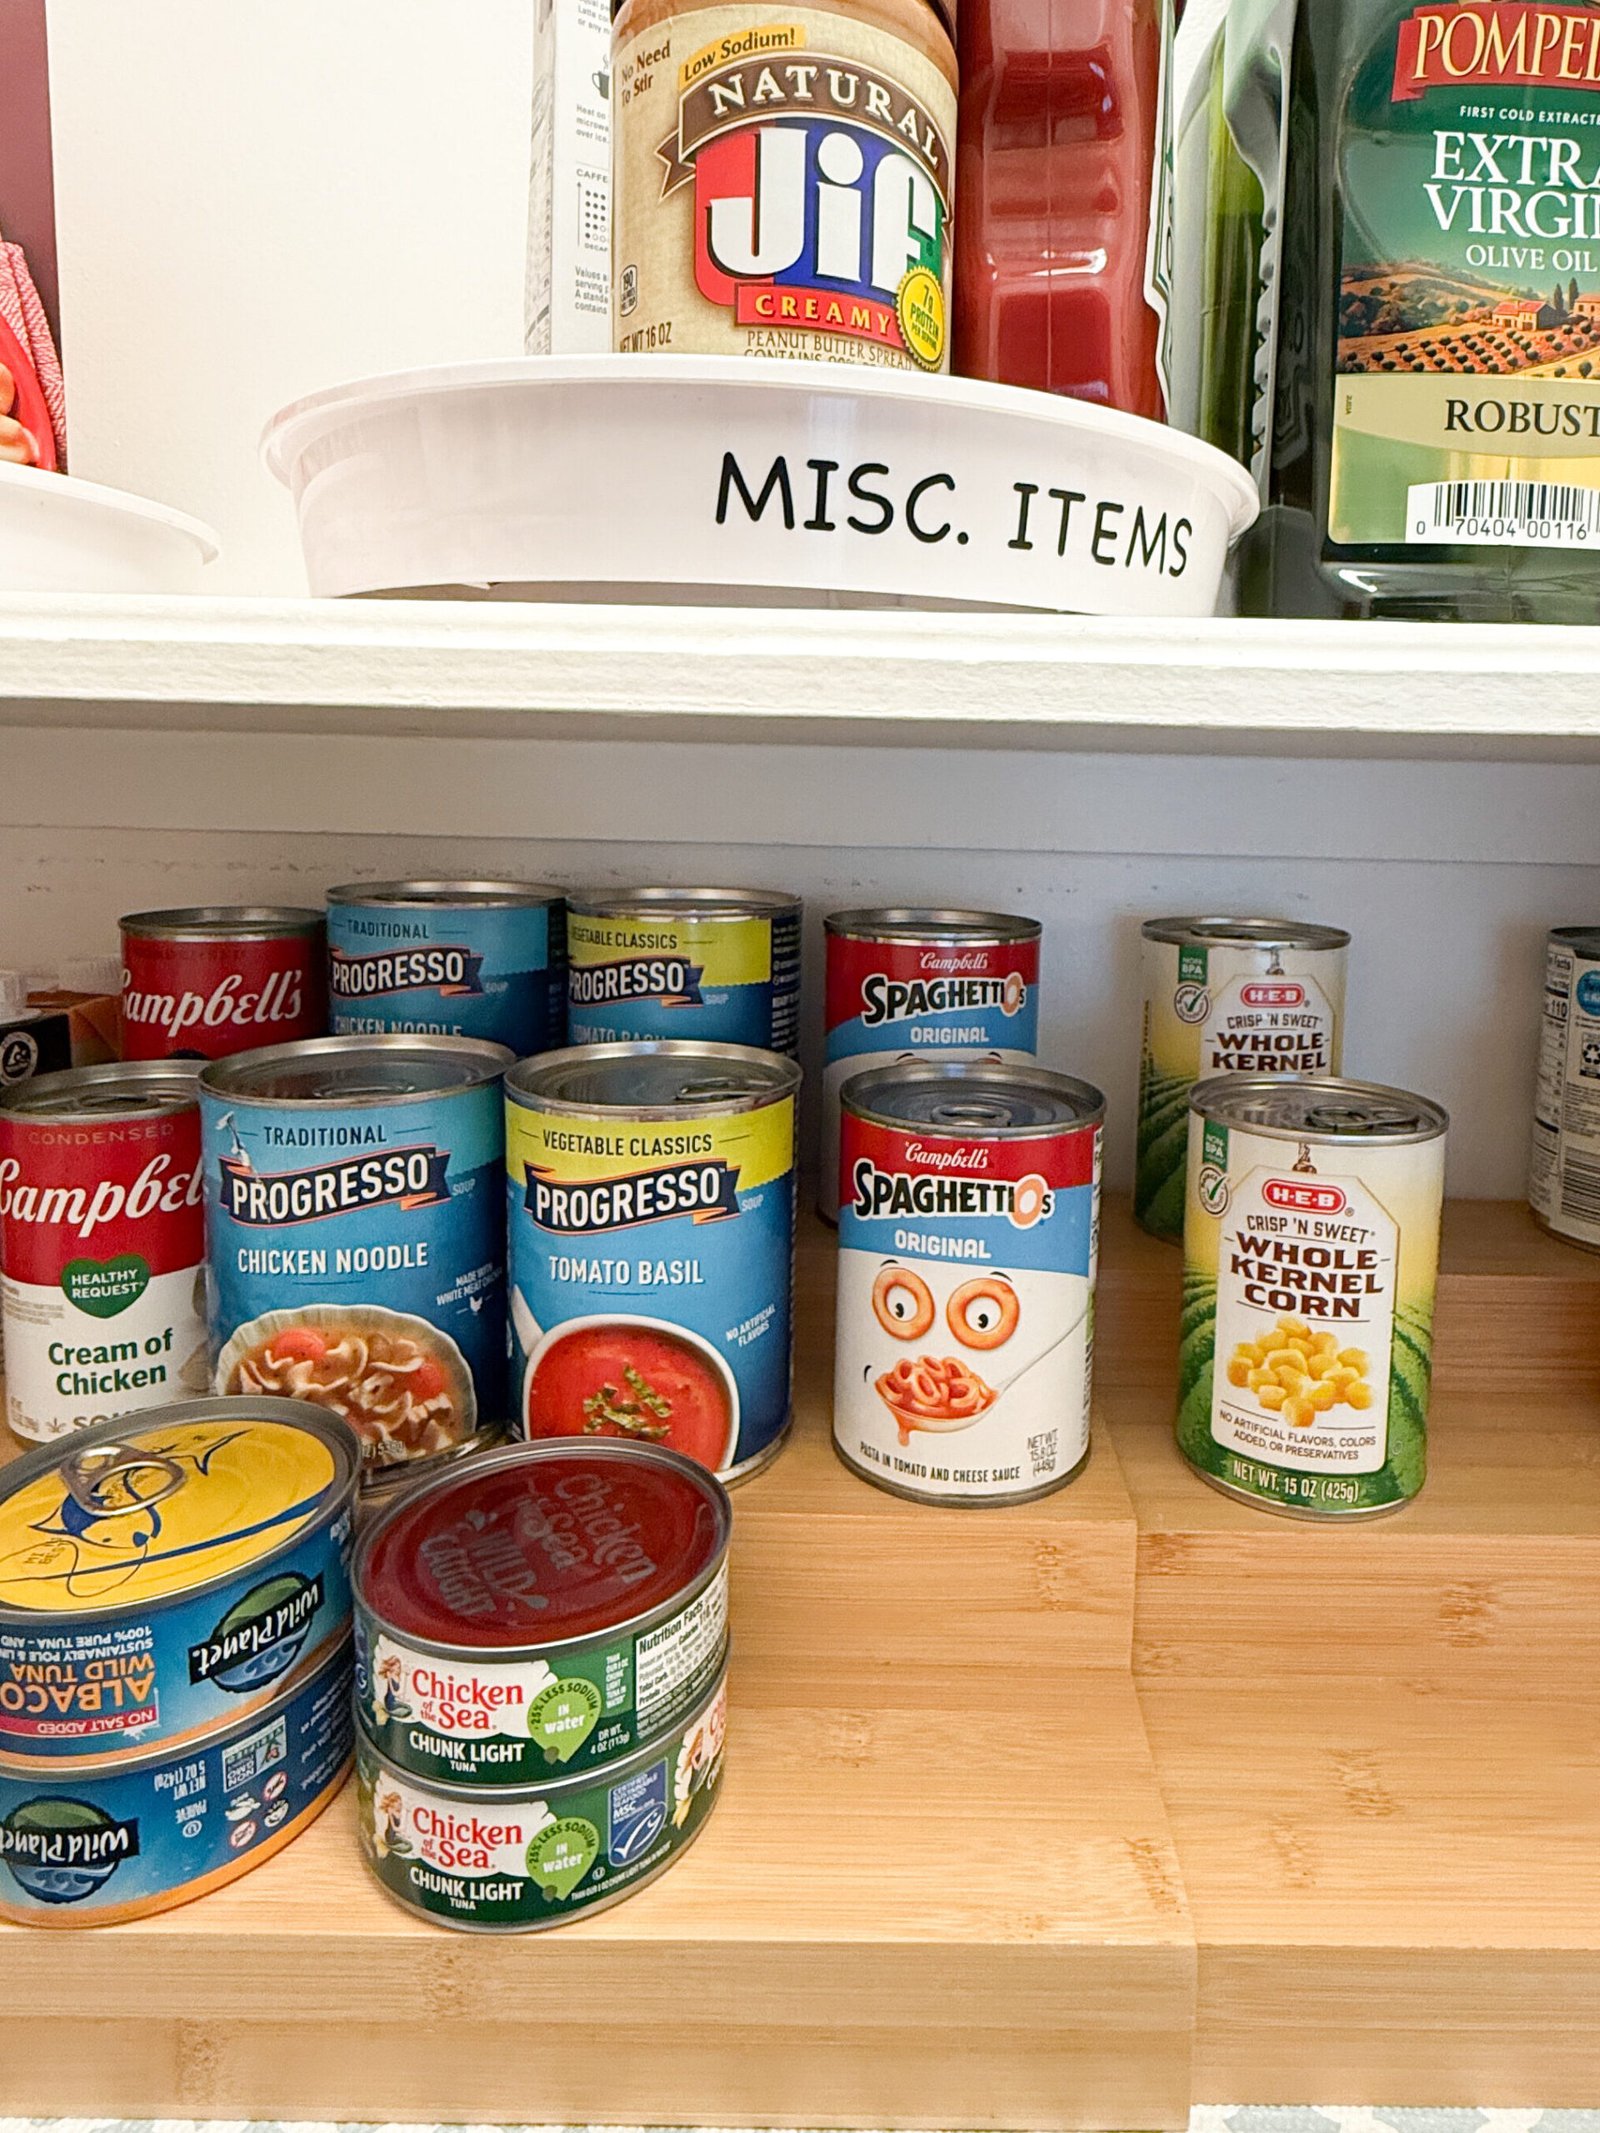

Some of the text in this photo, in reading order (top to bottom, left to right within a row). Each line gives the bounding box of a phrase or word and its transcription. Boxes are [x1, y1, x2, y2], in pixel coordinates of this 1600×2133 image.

[621, 40, 671, 86] No Need
[684, 27, 795, 82] Low Sodium!
[634, 73, 653, 98] Stir
[708, 64, 938, 166] NATURAL
[1460, 106, 1495, 119] FIRST
[1500, 108, 1534, 122] COLD
[1431, 130, 1600, 189] EXTR
[705, 127, 936, 295] Jif
[1423, 184, 1600, 239] VIRGI
[1466, 245, 1598, 272] OLIVE OIL
[755, 294, 890, 336] CREAMY
[910, 302, 939, 341] PROTEIN
[631, 322, 672, 352] WT 16 OZ
[747, 330, 808, 349] PEANUT
[814, 333, 865, 359] BUTTER
[869, 346, 912, 371] SPREAD
[715, 451, 1193, 578] MISC. ITEMS
[1416, 518, 1587, 541] 0 70404 00116
[347, 919, 430, 939] TRADITIONAL
[616, 932, 677, 949] CLASSICS
[332, 952, 464, 995] PROGRESSO
[920, 951, 988, 972] Campbell's
[1182, 964, 1202, 974] BPA
[569, 962, 684, 1001] PROGRESSO
[910, 1027, 989, 1043] ORIGINAL
[1227, 1015, 1319, 1029] CRISP SWEET
[1216, 1032, 1324, 1051] WHOLE
[1212, 1052, 1326, 1072] KERNEL
[28, 1123, 174, 1146] CONDENSED
[264, 1125, 387, 1147] TRADITIONAL
[543, 1129, 712, 1156] VEGETABLE CLASSICS
[905, 1141, 988, 1170] Campbell's
[232, 1153, 476, 1221] PROGRESSO SOUP
[536, 1167, 764, 1227] PROGRESSO SOUP
[1247, 1215, 1369, 1244] CRISP SWEET
[895, 1229, 992, 1259] ORIGINAL
[1236, 1231, 1378, 1270] WHOLE
[238, 1242, 428, 1274] CHICKEN NOODLE
[549, 1256, 704, 1285] TOMATO BASIL
[71, 1269, 138, 1286] HEALTHY
[456, 1271, 477, 1287] MADE
[1231, 1253, 1384, 1294] KERNEL
[72, 1281, 139, 1299] REQUEST
[436, 1288, 462, 1306] WHITE
[1244, 1283, 1361, 1318] CORN
[725, 1303, 775, 1341] NO ARTIFICIAL
[738, 1320, 770, 1347] FLAVORS
[48, 1327, 173, 1366] Cream of
[56, 1364, 167, 1396] Chicken
[1027, 1434, 1043, 1449] NET
[1219, 1409, 1376, 1447] NO ARTIFICIAL FLAVORS, COLORS
[1233, 1430, 1359, 1460] ADDED, OR PRESERVATIVES
[860, 1441, 1020, 1483] PASTA IN TOMATO AND CHEESE SAUCE
[1233, 1460, 1359, 1503] NET WT. 15 OZ (425g)
[277, 1583, 318, 1633] Wild
[76, 1632, 111, 1647] PURE
[115, 1626, 152, 1642] 100%
[639, 1600, 703, 1655] Nutrition Facts
[28, 1637, 154, 1663] SUSTAINABLY POLE
[37, 1636, 72, 1649] TUNA
[10, 1653, 155, 1683] WILD TUNA
[412, 1669, 524, 1711] Chicken
[540, 1682, 598, 1711] LESS SODIUM
[420, 1710, 436, 1722] the
[422, 1701, 433, 1712] of
[438, 1703, 490, 1729] Sea
[558, 1703, 569, 1716] IN
[37, 1709, 153, 1735] NO SALT ADDED
[544, 1715, 584, 1735] water
[410, 1730, 524, 1762] CHUNK LIGHT
[227, 1768, 254, 1787] NON
[450, 1760, 476, 1773] TUNA
[173, 1775, 206, 1800] NET WT
[614, 1801, 636, 1818] MSC
[412, 1807, 523, 1851] Chicken
[538, 1822, 596, 1849] LESS SODIUM
[68, 1827, 129, 1863] Wild
[423, 1839, 433, 1850] of
[438, 1841, 490, 1868] Sea
[543, 1853, 583, 1873] water
[410, 1867, 524, 1901] CHUNK LIGHT
[450, 1898, 476, 1910] TUNA
